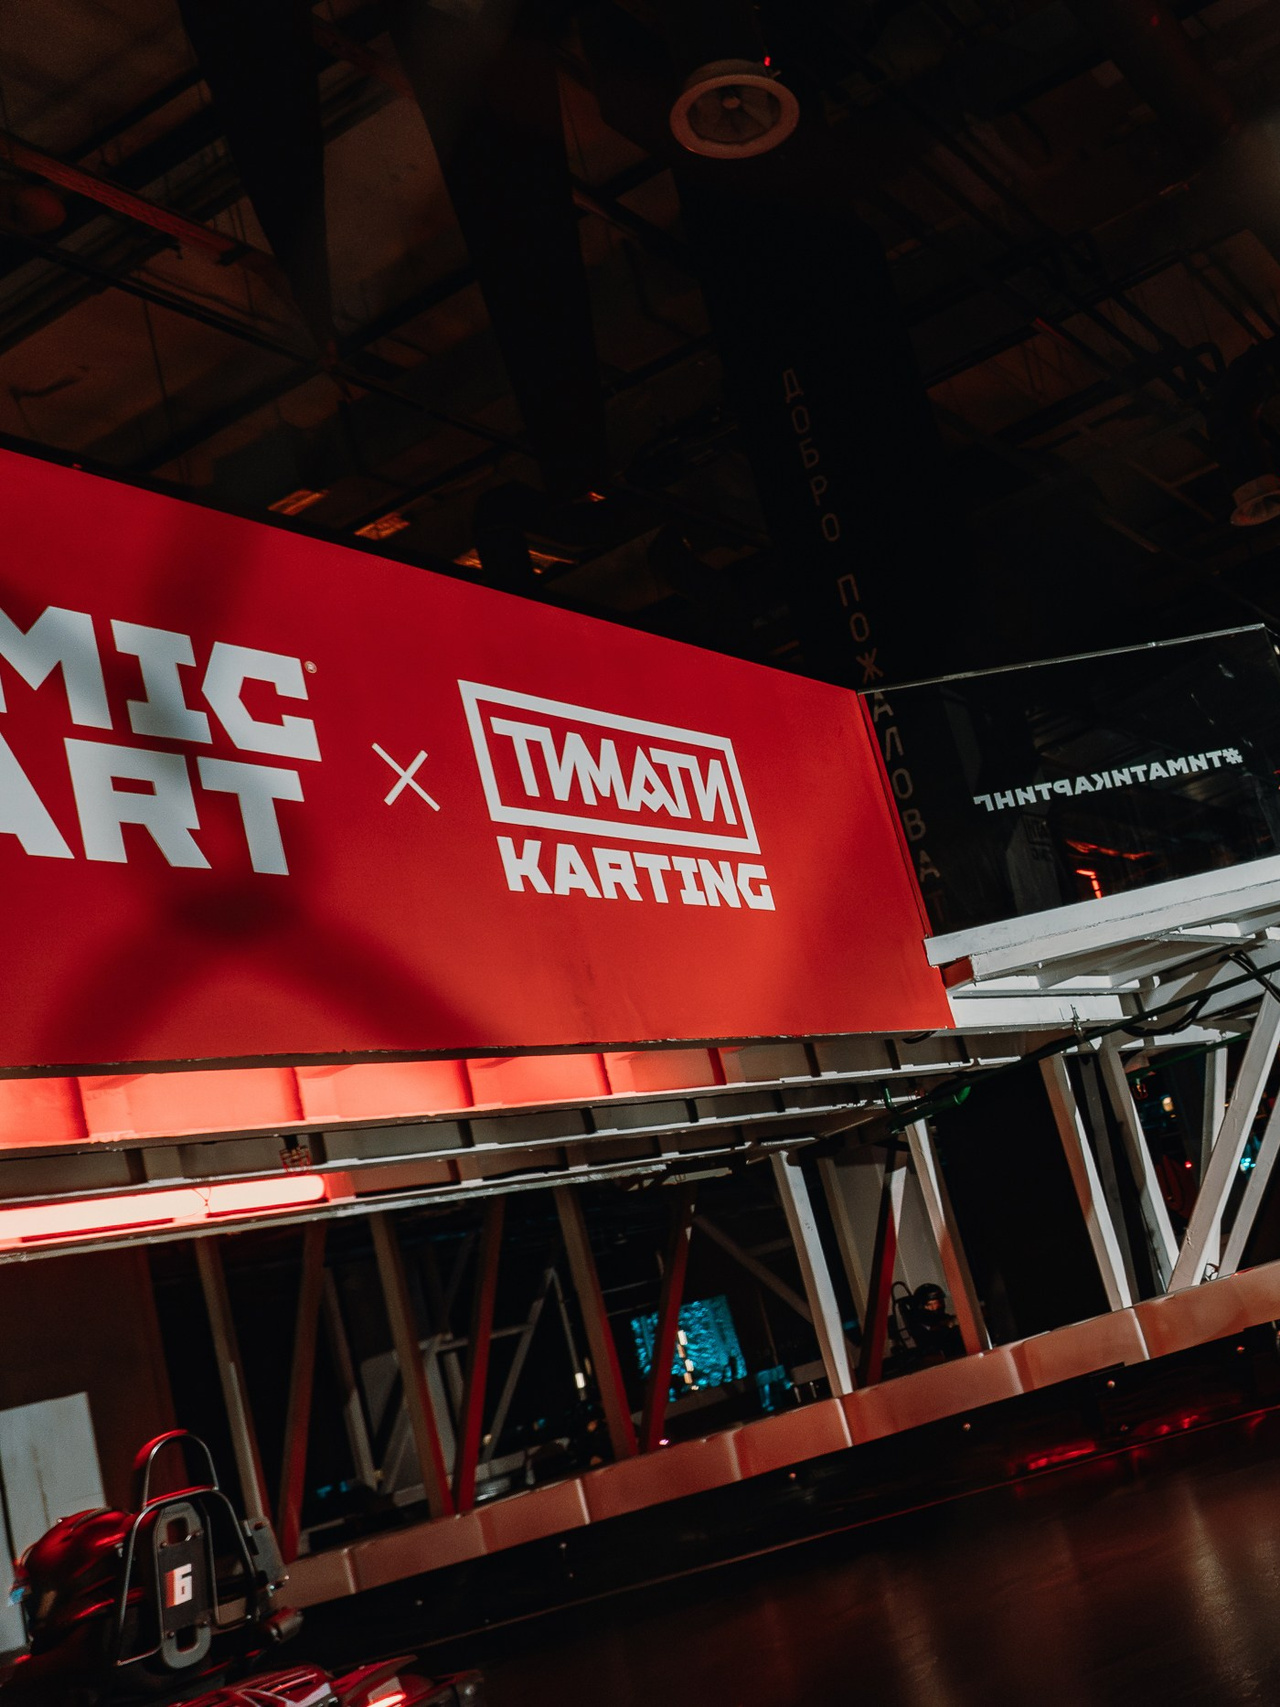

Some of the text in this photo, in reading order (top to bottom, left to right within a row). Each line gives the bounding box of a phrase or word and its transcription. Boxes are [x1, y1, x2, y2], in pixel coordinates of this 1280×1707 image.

[782, 367, 841, 542] ДОБРО
[496, 835, 776, 911] KARTING
[166, 1563, 192, 1607] 6
